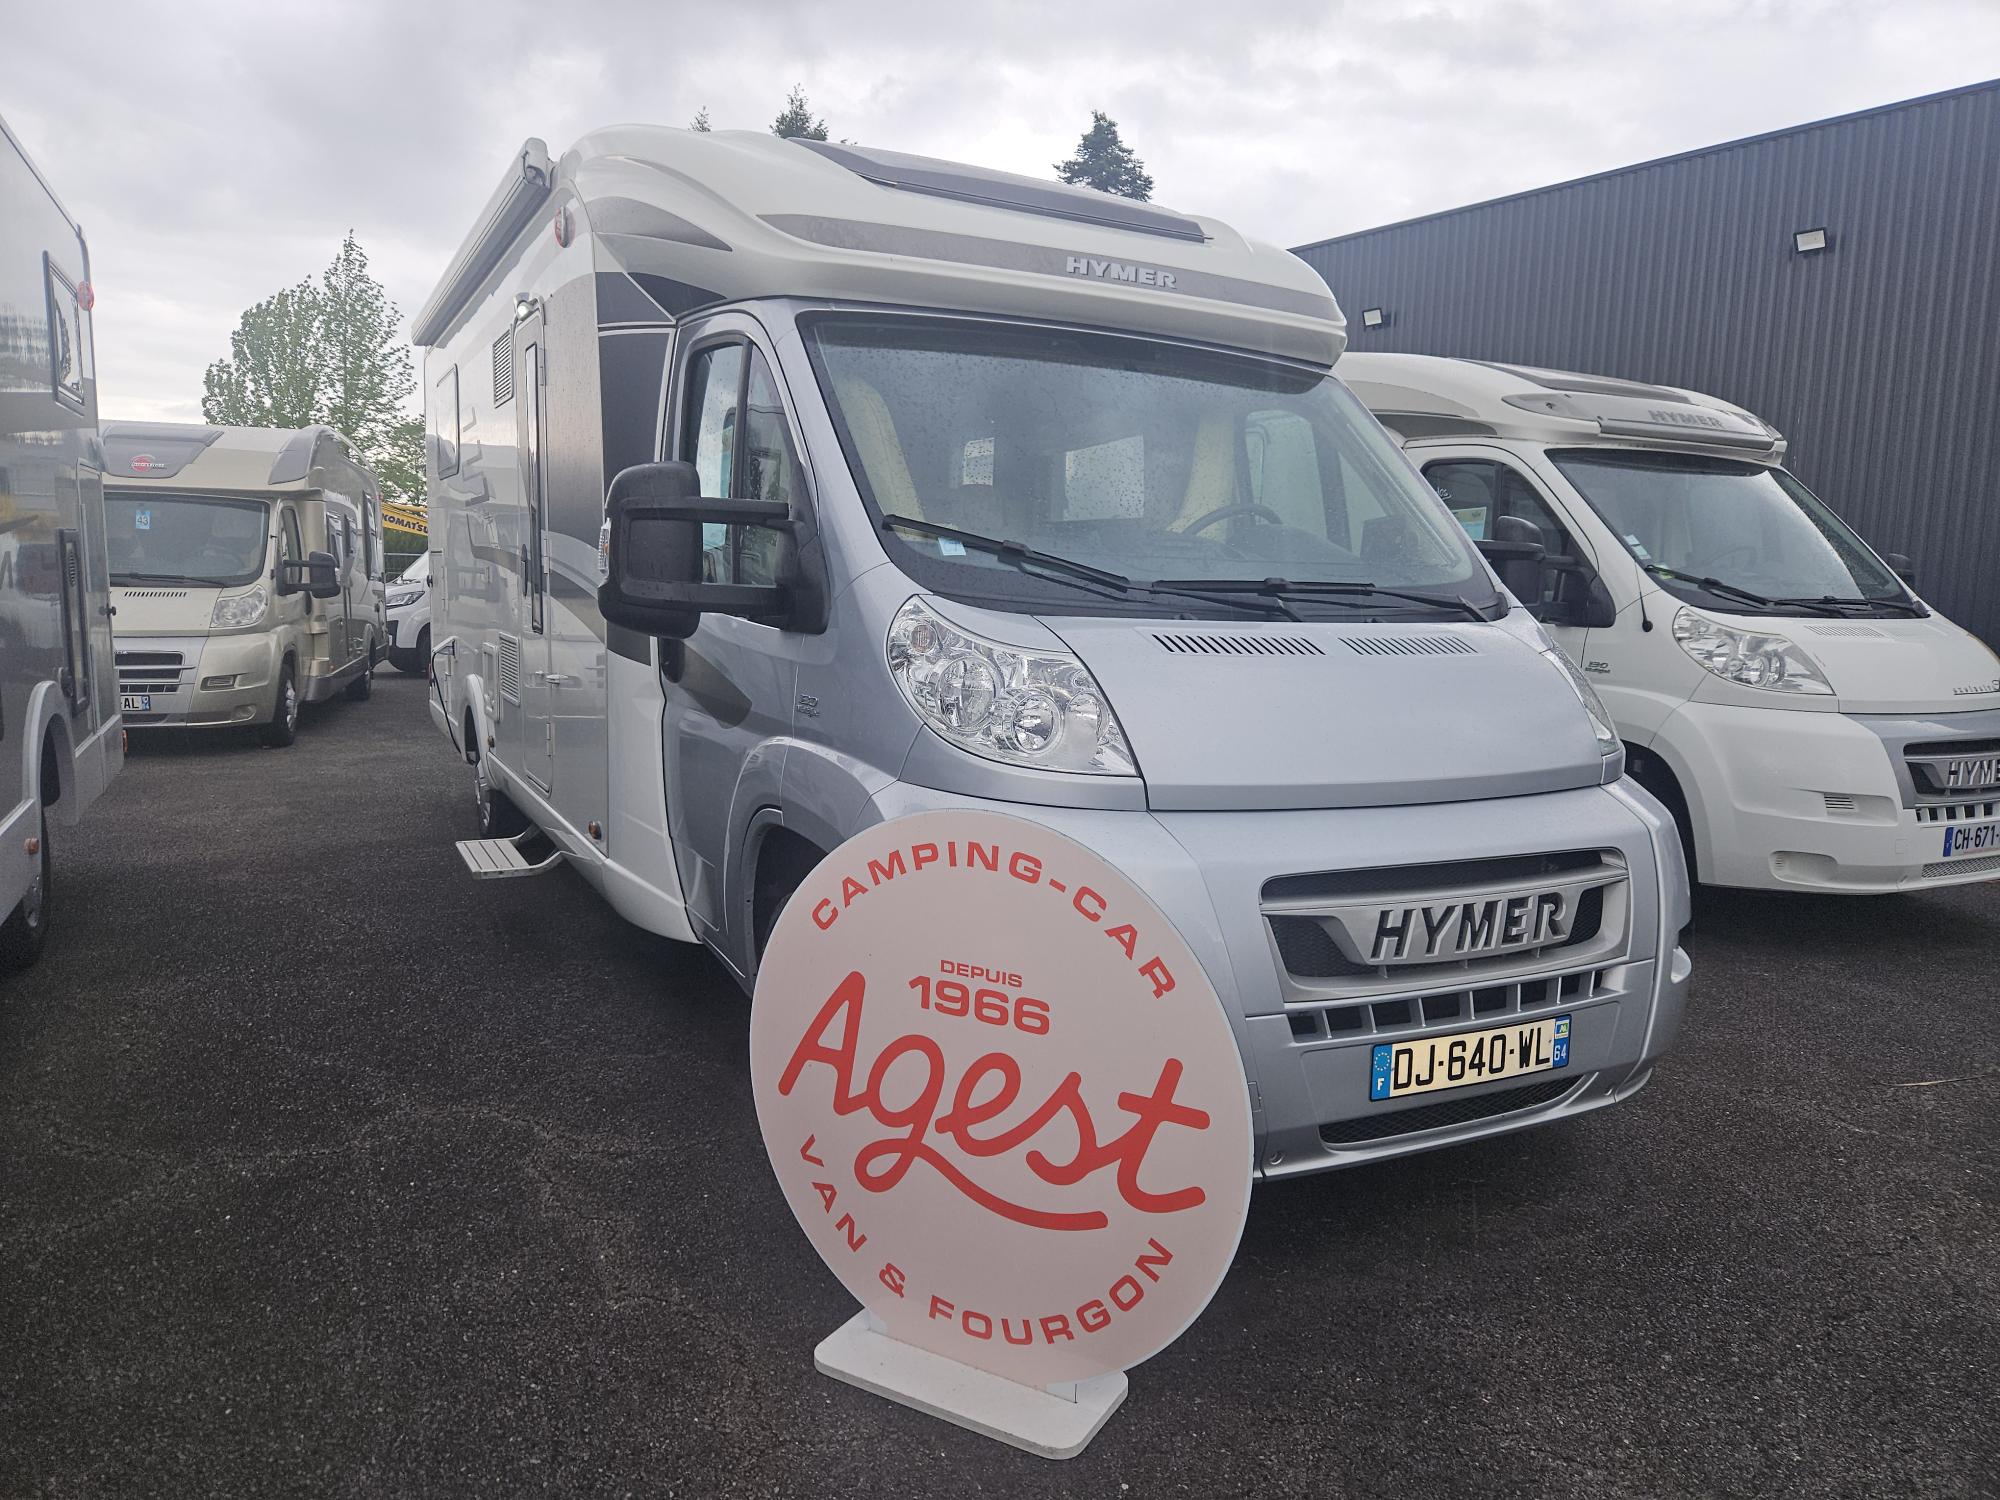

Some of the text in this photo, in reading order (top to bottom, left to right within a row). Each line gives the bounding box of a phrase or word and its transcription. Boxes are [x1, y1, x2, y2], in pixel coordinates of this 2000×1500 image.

[1066, 256, 1177, 289] HYMER
[1648, 409, 1726, 430] HYMER
[812, 841, 1176, 998] CAMPING-CAR
[1370, 891, 1568, 961] HYMER
[940, 960, 1022, 989] DEPUIS
[908, 976, 1050, 1036] 1966
[1377, 1077, 1385, 1091] F
[1554, 1044, 1567, 1061] 64
[778, 971, 1210, 1230] Agest
[800, 1136, 1173, 1345] VAN & FOURGON
